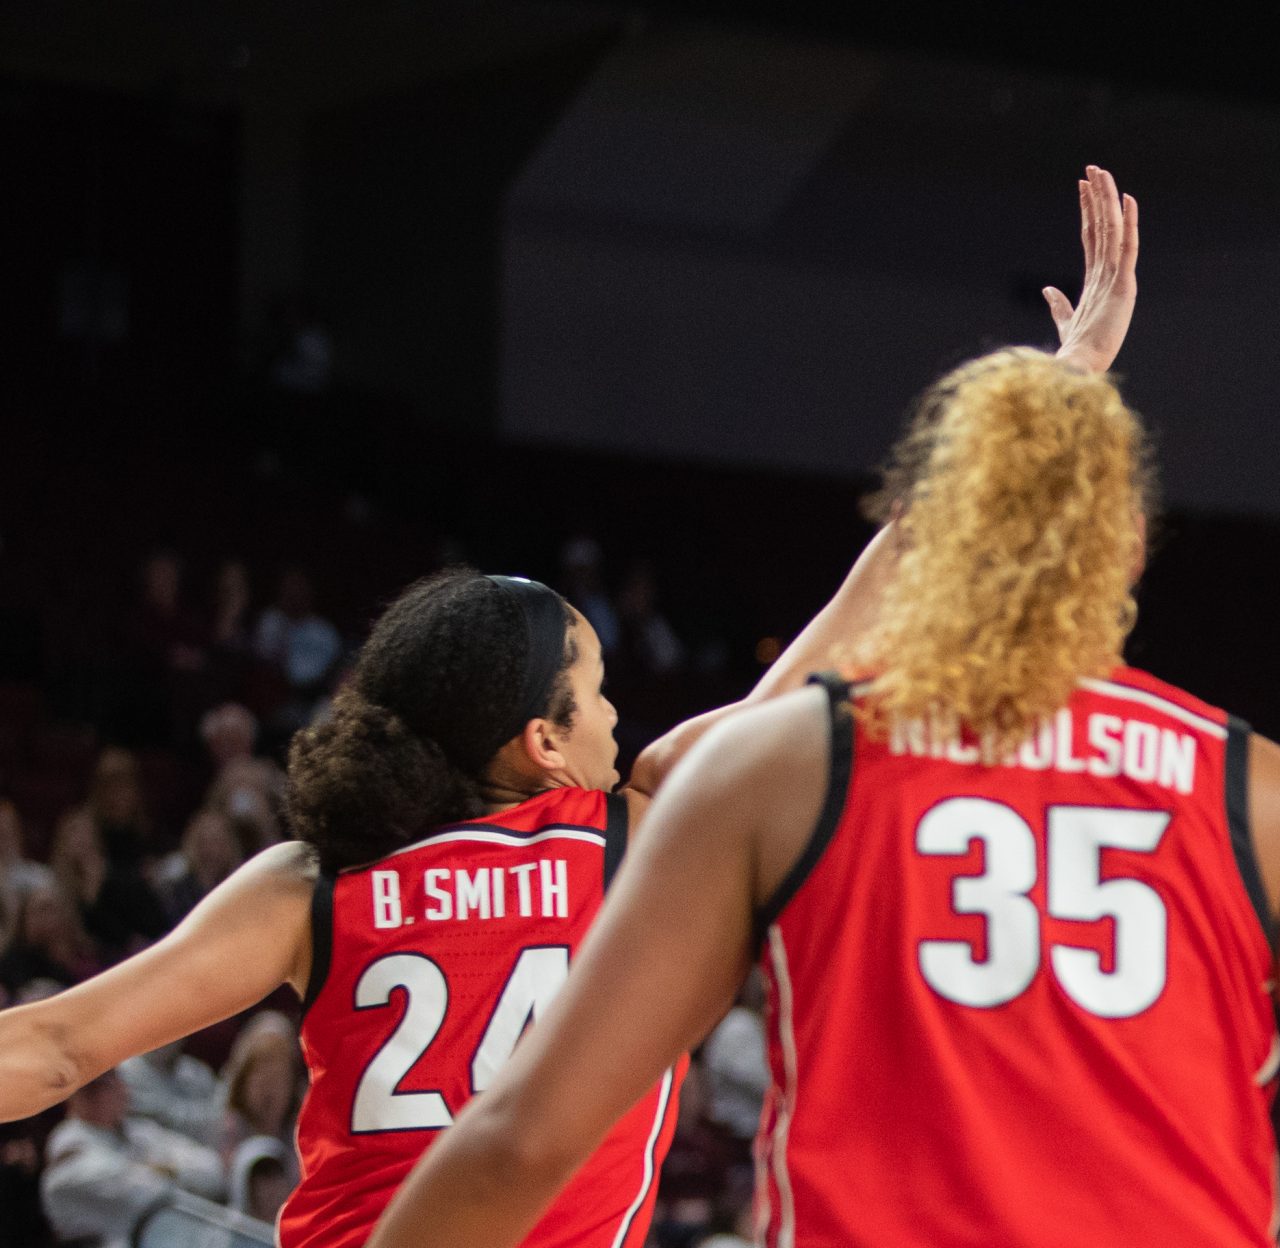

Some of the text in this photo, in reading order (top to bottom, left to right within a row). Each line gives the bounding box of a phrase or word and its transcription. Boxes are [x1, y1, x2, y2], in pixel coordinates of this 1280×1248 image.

[371, 858, 569, 929] B. SMITH
[914, 796, 1172, 1020] 35
